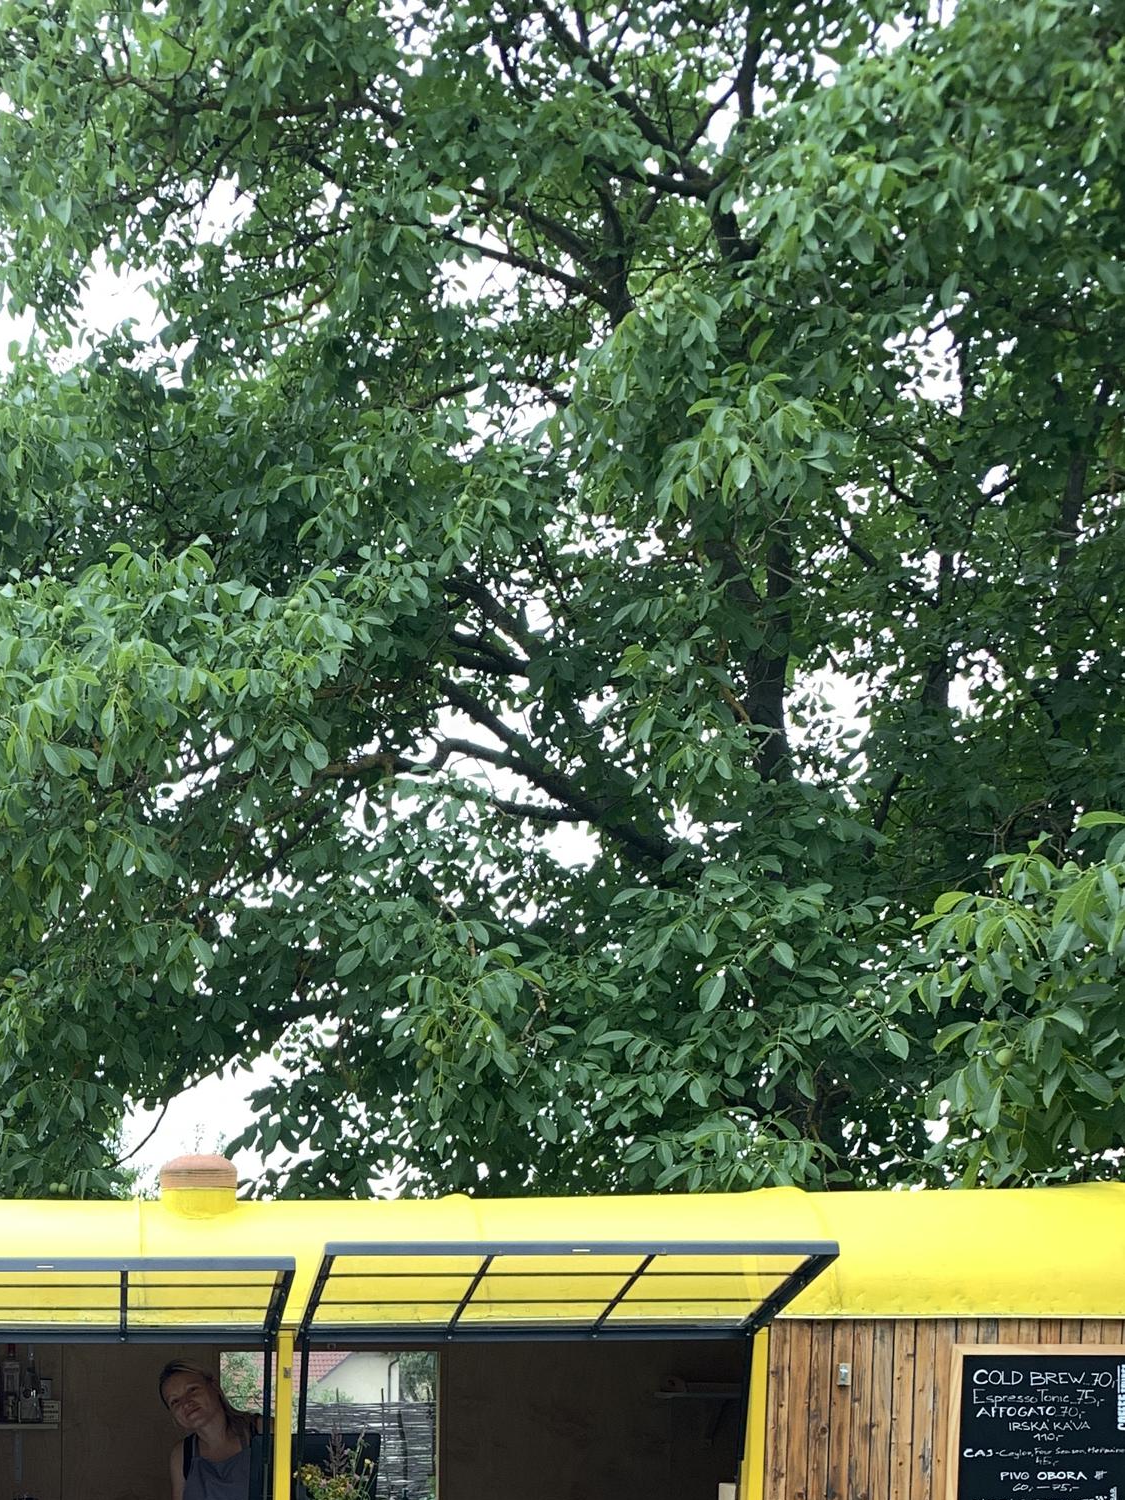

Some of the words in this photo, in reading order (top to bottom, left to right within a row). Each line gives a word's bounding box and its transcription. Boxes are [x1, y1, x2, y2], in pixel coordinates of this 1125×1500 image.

[972, 1368, 1024, 1386] COLD
[972, 1388, 1038, 1408] Espresso
[999, 1471, 1030, 1481] PIVO
[1036, 1470, 1088, 1481] OBORA
